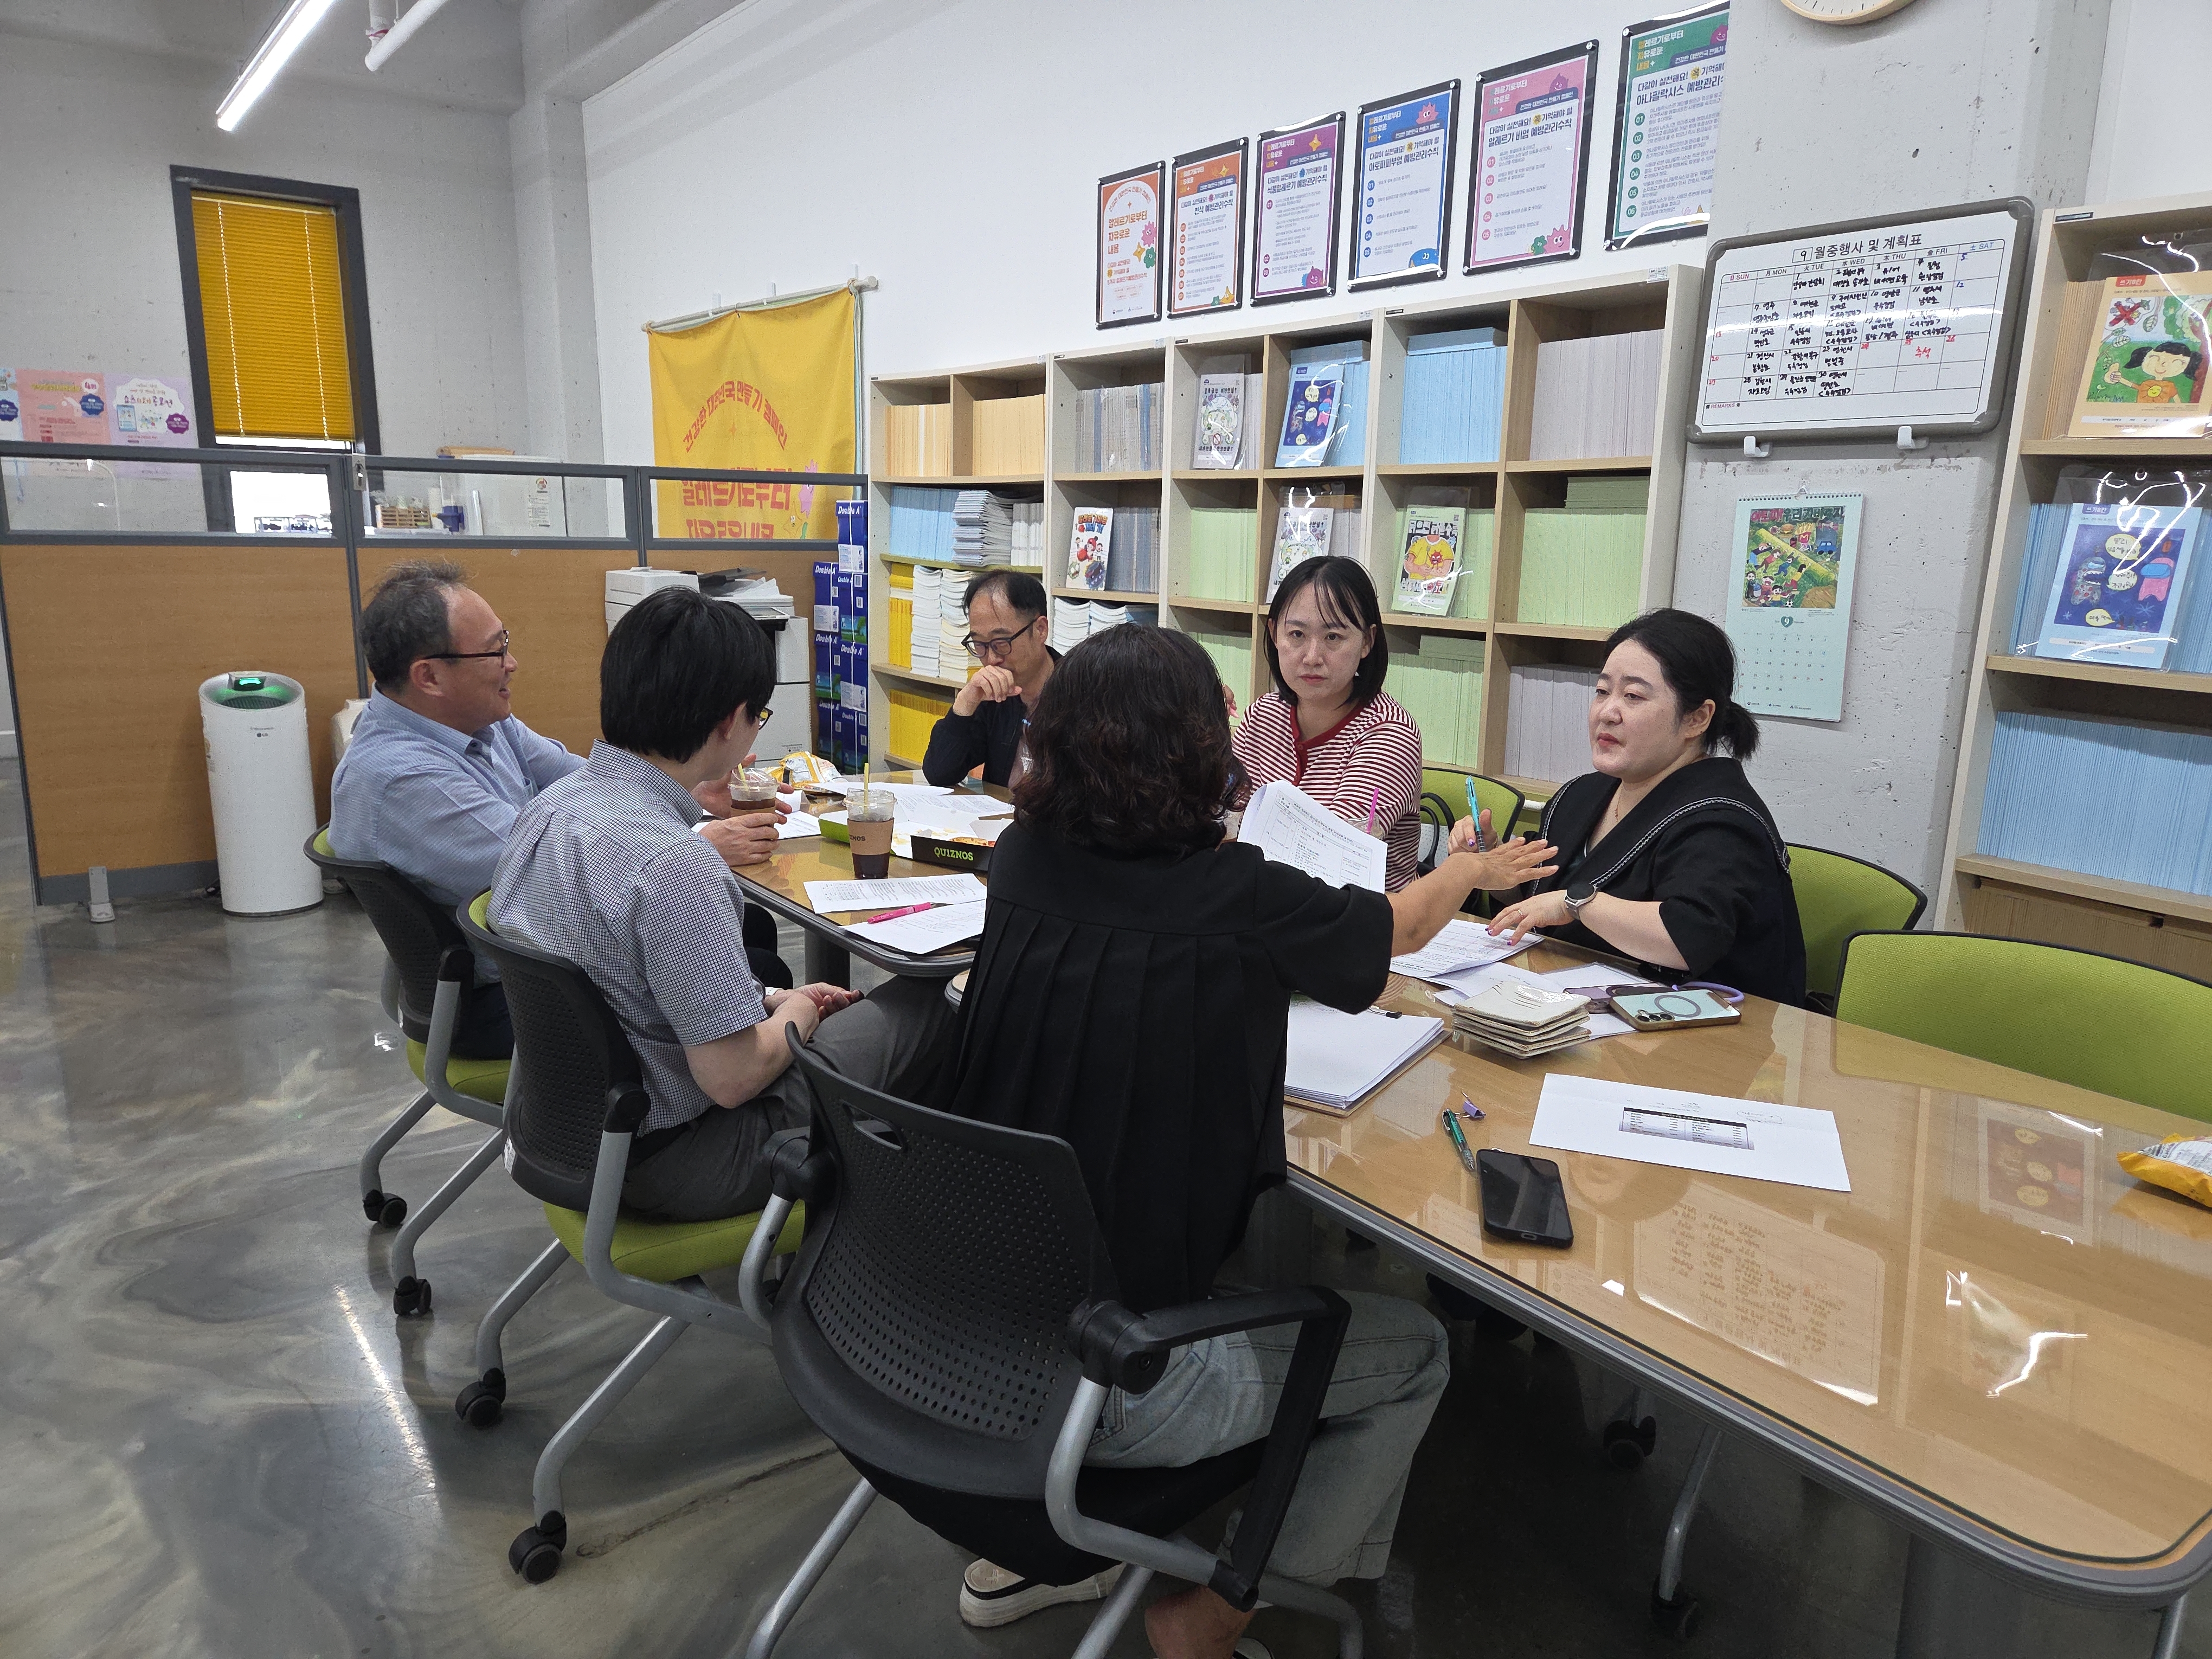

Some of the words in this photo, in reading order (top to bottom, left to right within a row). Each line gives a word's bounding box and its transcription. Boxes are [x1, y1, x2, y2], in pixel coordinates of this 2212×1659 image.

[1638, 80, 1658, 92] 다같이
[1660, 72, 1689, 87] 실천해요!
[1636, 84, 1684, 105] 아나필락시스
[1489, 132, 1514, 147] 알레르기
[1516, 129, 1529, 141] 비염
[1531, 118, 1572, 137] 예방관리수칙
[1490, 124, 1505, 134] 다같이
[1507, 118, 1531, 131] 실천해요!
[1369, 151, 1383, 160] 다같이
[1369, 156, 1403, 171] 아토피피부염
[1404, 146, 1439, 163] 예방관리수칙
[1108, 210, 1147, 228] 알레르기로부터
[1801, 250, 1807, 261] 9
[1814, 241, 1863, 259] 월중행사
[1868, 239, 1879, 253] 및
[1882, 234, 1921, 248] 계획표
[1849, 258, 1865, 266] WED
[1915, 346, 1931, 359] 추석
[683, 406, 707, 453] 건강한
[706, 381, 735, 416] 대한민국
[737, 381, 763, 412] 만들기
[856, 506, 860, 515] A
[815, 565, 831, 574] Double
[1784, 618, 1789, 626] 9
[815, 634, 832, 644] Double
[833, 636, 837, 644] A
[841, 644, 857, 654] Double
[858, 647, 862, 656] A
[934, 847, 974, 861] QUIZNOS
